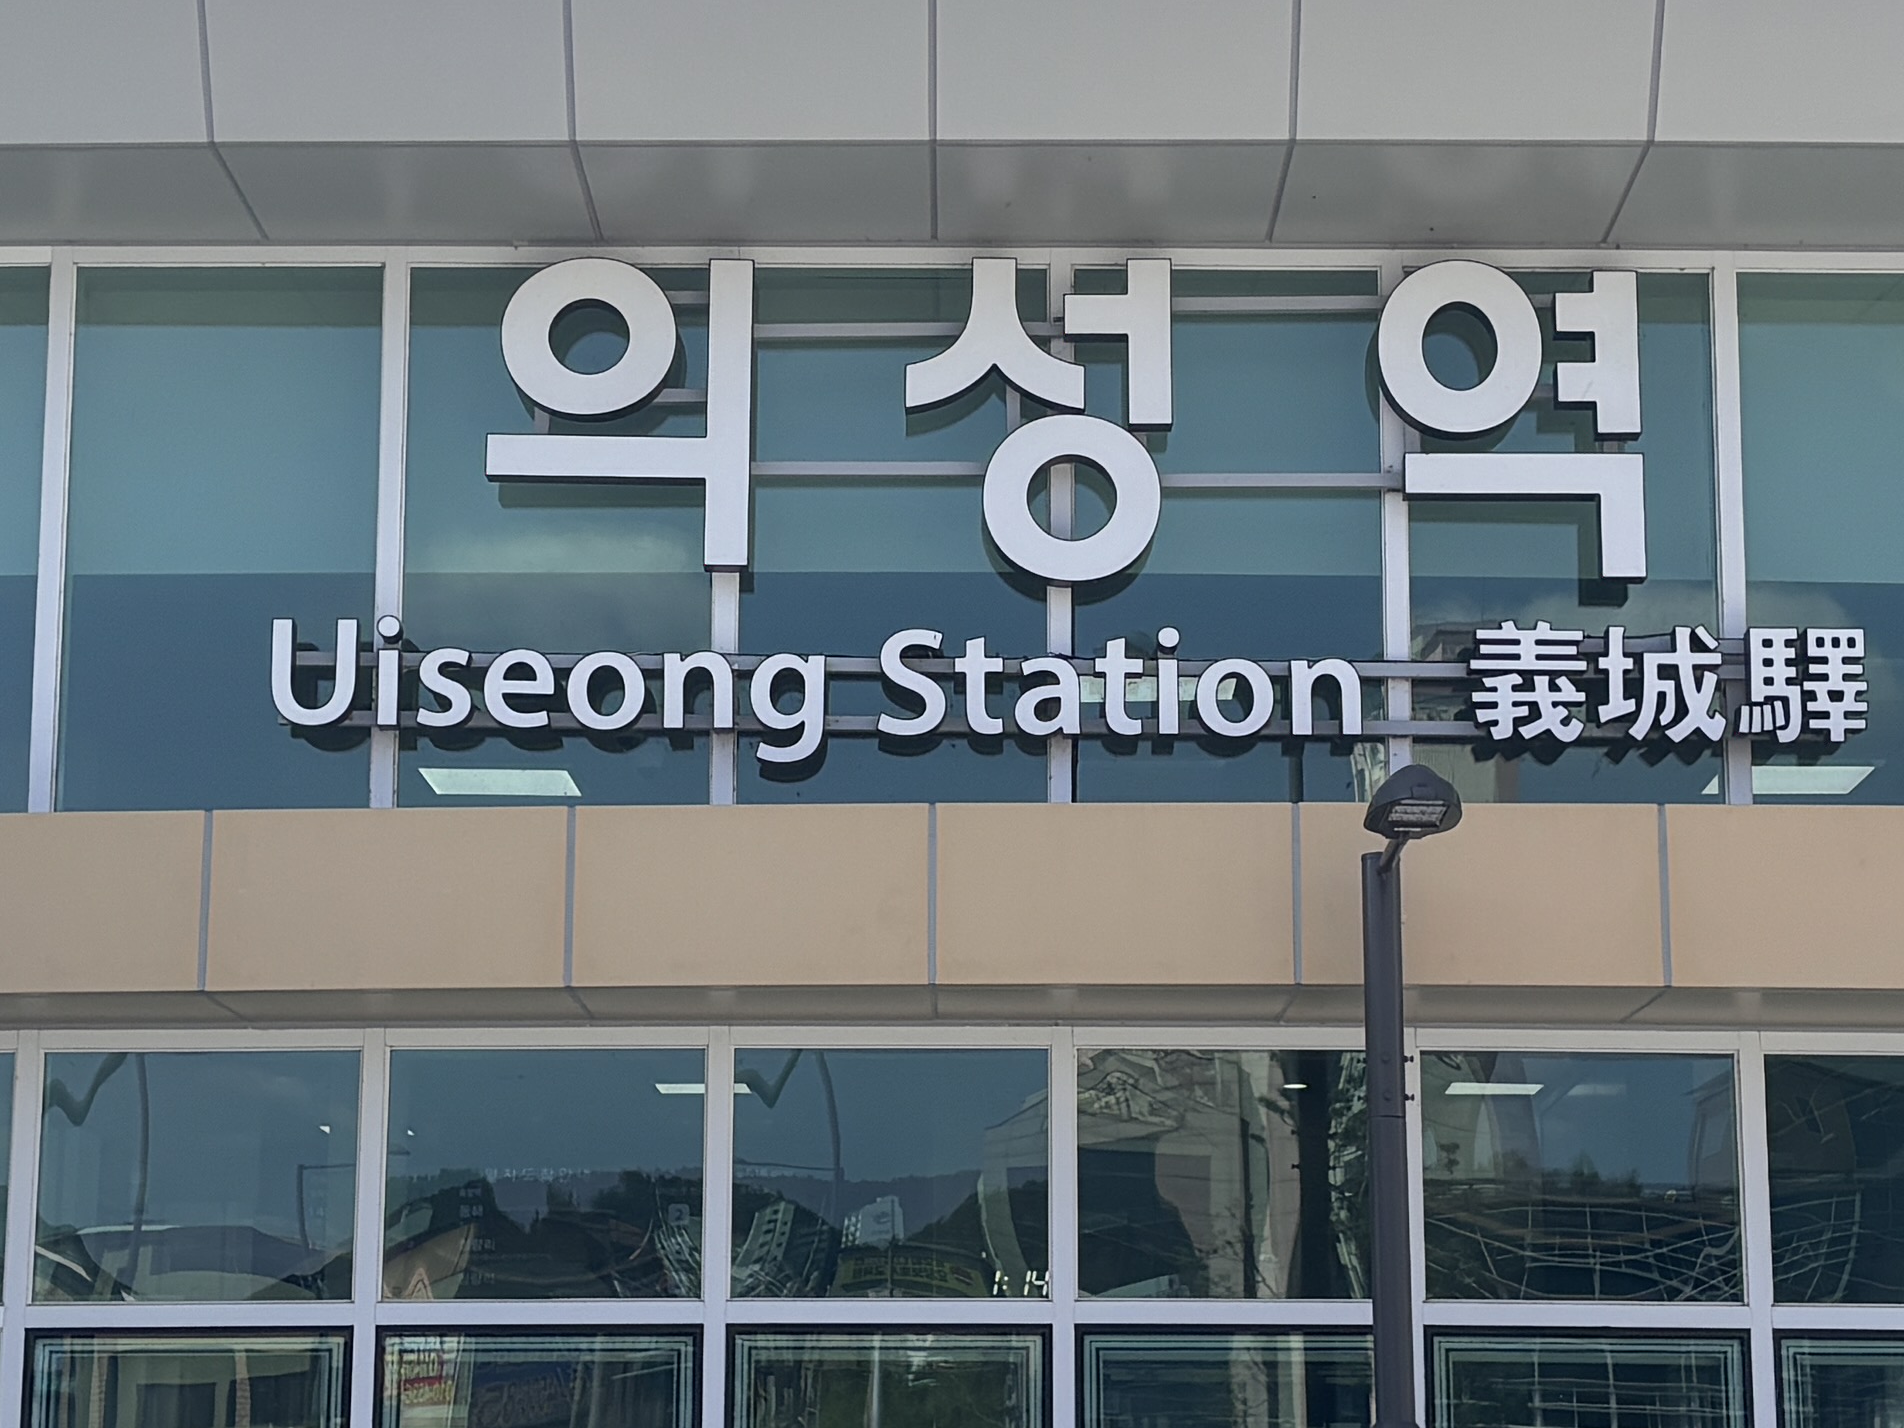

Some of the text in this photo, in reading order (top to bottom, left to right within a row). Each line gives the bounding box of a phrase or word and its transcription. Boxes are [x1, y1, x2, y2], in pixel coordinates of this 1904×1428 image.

[485, 257, 1647, 585] 의성역
[268, 615, 1869, 764] Uiseong Station 義城驛
[992, 1270, 1050, 1296] 1:14
